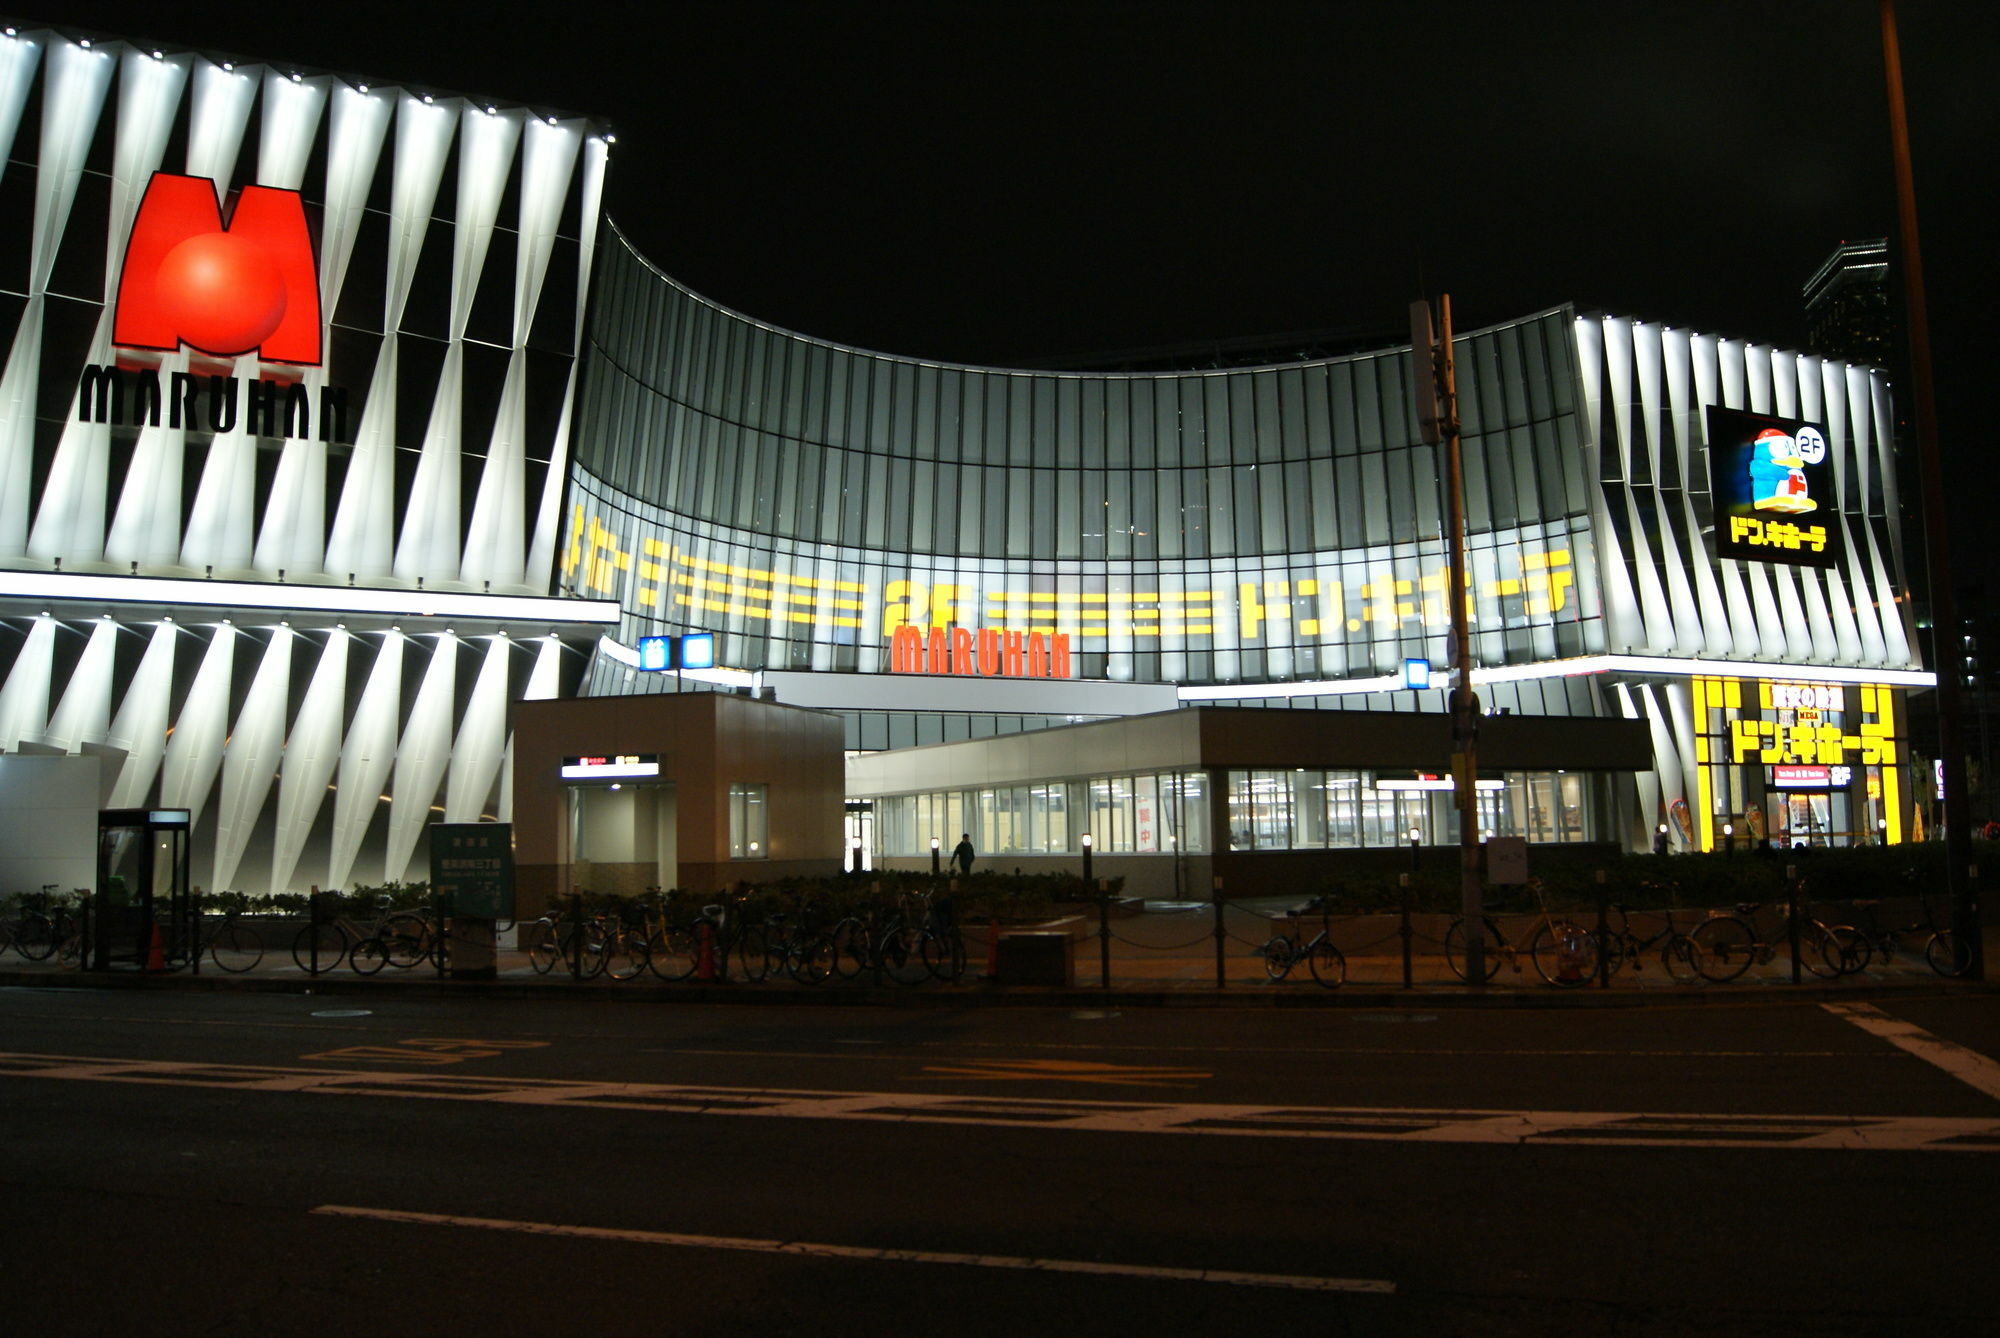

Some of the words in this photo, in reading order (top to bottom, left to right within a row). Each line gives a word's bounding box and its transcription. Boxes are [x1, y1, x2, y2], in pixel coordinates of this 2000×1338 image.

[79, 364, 348, 443] MARUHAN
[1800, 435, 1821, 455] 2F
[884, 580, 971, 637] 2F
[891, 625, 1071, 679] MARUHAN
[1799, 711, 1819, 720] MEGA
